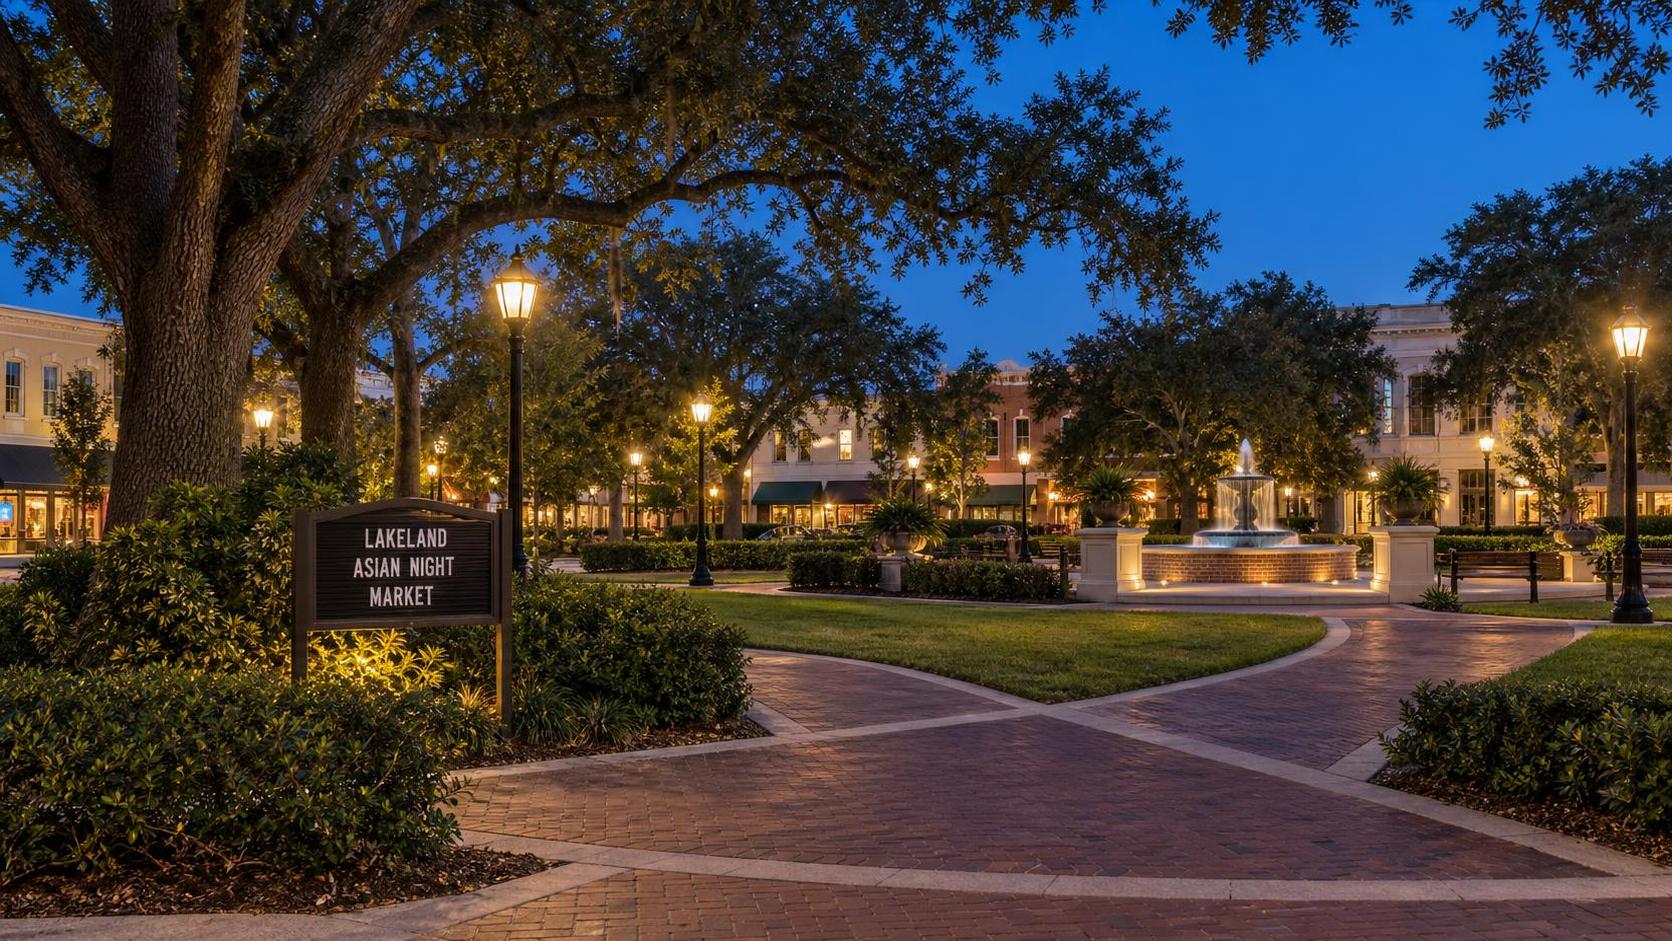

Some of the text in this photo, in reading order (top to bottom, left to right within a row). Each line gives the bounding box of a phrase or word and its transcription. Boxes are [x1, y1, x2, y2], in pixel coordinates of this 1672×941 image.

[365, 528, 447, 548] LAKELAND
[353, 556, 455, 578] ASIAN NIGHT
[370, 586, 434, 606] MARKET
